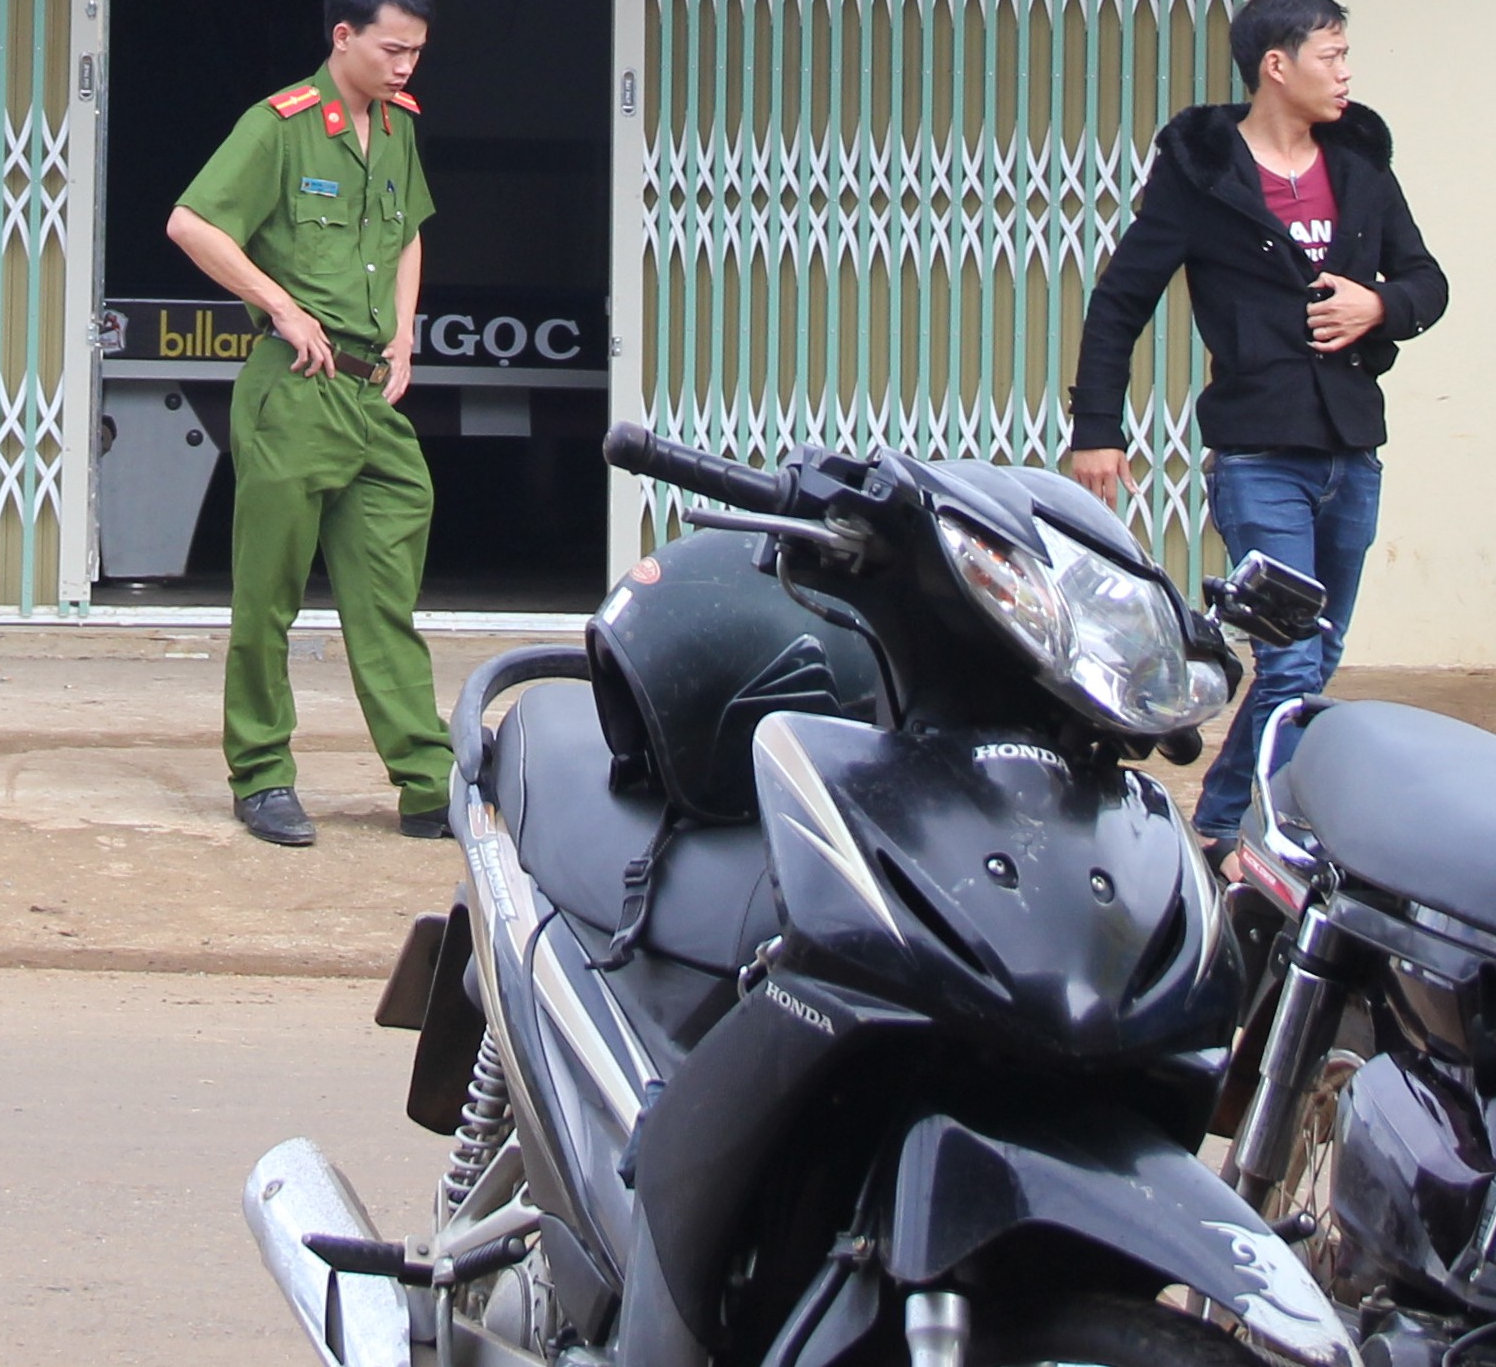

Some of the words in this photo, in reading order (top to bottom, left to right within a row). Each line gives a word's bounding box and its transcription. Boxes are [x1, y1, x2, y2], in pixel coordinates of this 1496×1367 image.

[160, 309, 265, 357] billar
[973, 743, 1072, 782] HONDA
[766, 980, 834, 1035] HONDA
